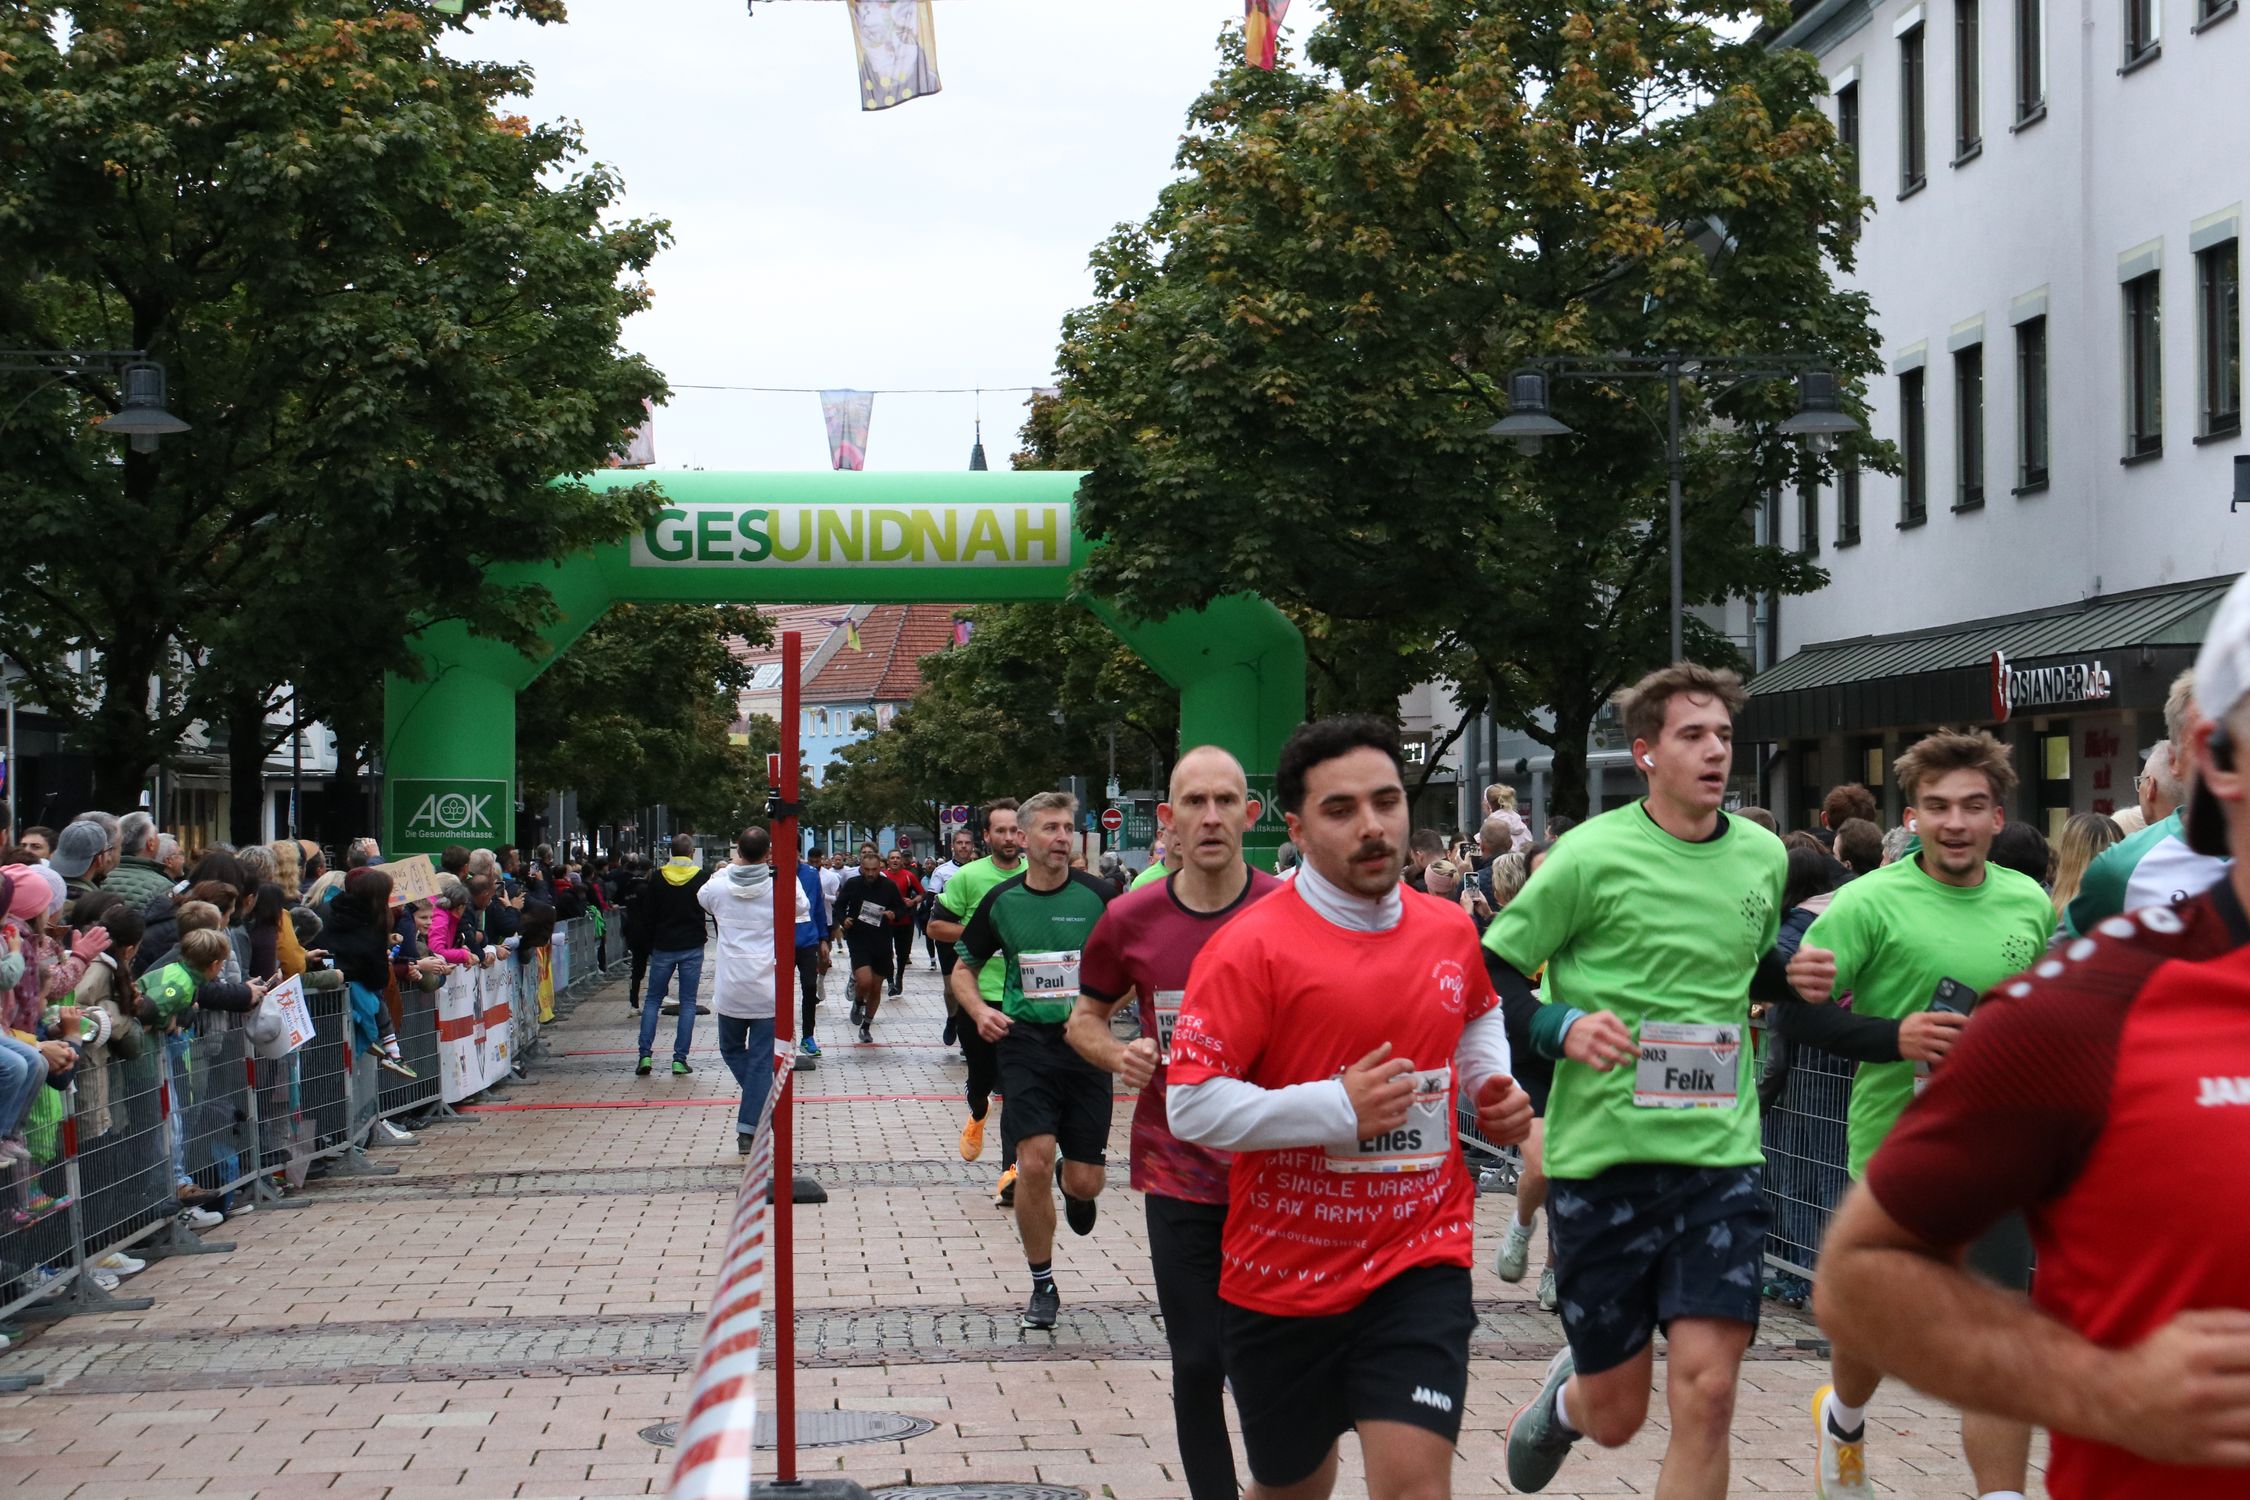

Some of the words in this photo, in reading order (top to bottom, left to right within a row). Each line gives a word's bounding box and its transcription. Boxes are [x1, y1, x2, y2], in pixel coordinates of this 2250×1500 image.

[645, 508, 1057, 562] GESUNDNAH
[2010, 661, 2111, 706] OSIANDER.de
[408, 793, 493, 829] AOK
[405, 829, 417, 838] Die
[418, 829, 495, 839] Gesundheitskasse.
[1035, 975, 1065, 989] Paul
[1664, 1067, 1715, 1091] Felix
[2195, 1075, 2250, 1107] JAK
[1276, 1173, 1356, 1198] SINGLE
[1250, 1191, 1271, 1209] IS
[1276, 1198, 1303, 1217] AN
[1313, 1203, 1384, 1224] ARMY
[1393, 1199, 1420, 1220] OF
[1411, 1384, 1452, 1412] JAKO
